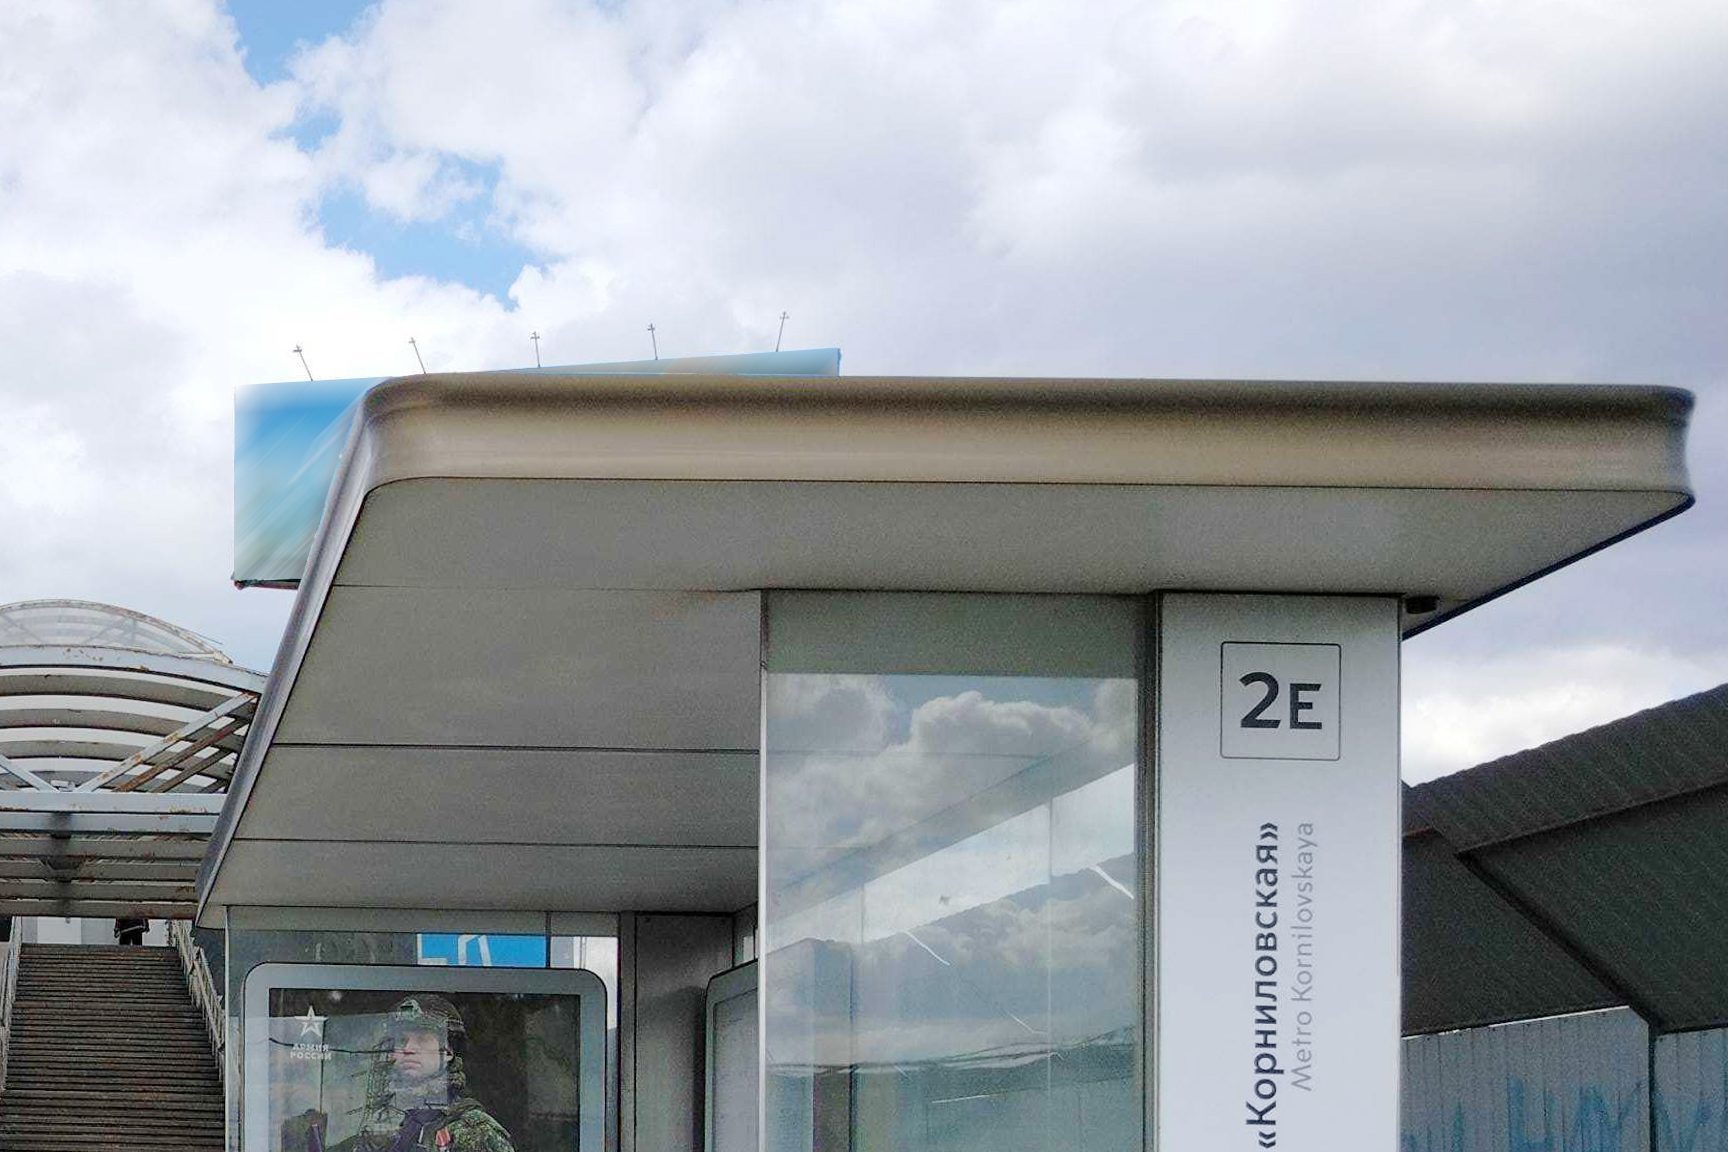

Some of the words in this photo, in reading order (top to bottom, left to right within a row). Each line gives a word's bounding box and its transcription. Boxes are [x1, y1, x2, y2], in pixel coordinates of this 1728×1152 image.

[1290, 821, 1318, 1003] Kornilovskaya
[1244, 821, 1286, 1149] «Корниловская»
[1290, 1010, 1313, 1092] Metro
[290, 1051, 332, 1060] РОССИИ
